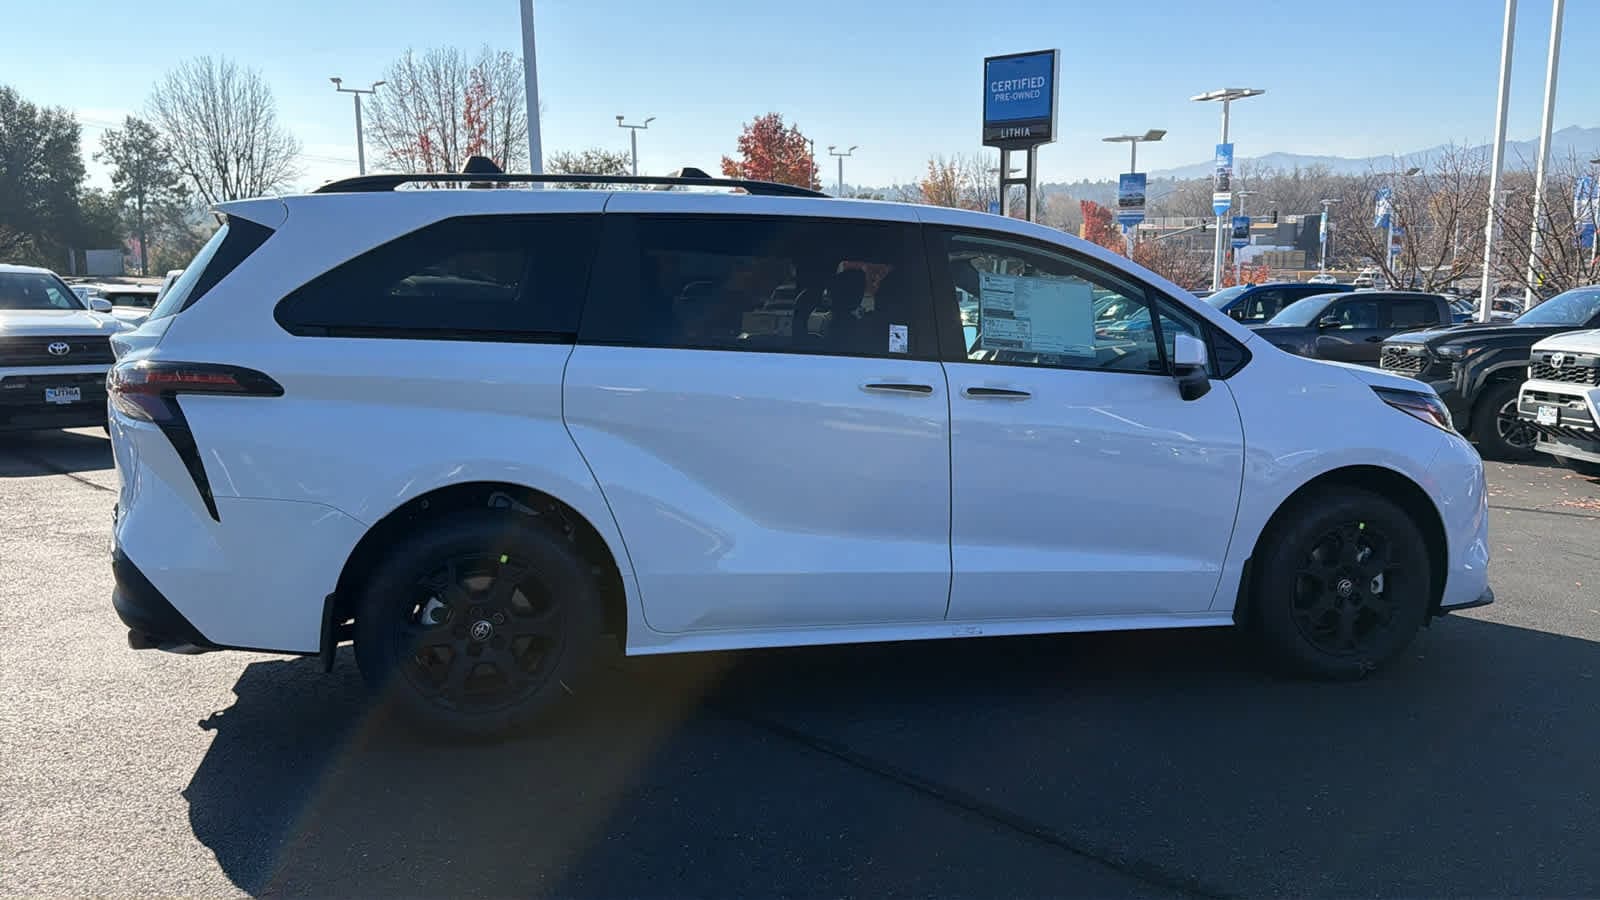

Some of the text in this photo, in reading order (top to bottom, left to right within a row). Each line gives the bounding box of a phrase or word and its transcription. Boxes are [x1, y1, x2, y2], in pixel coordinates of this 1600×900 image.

[991, 76, 1045, 92] CERTIFIED
[995, 90, 1041, 102] PRE-OWNED
[1001, 128, 1031, 137] LITHIA
